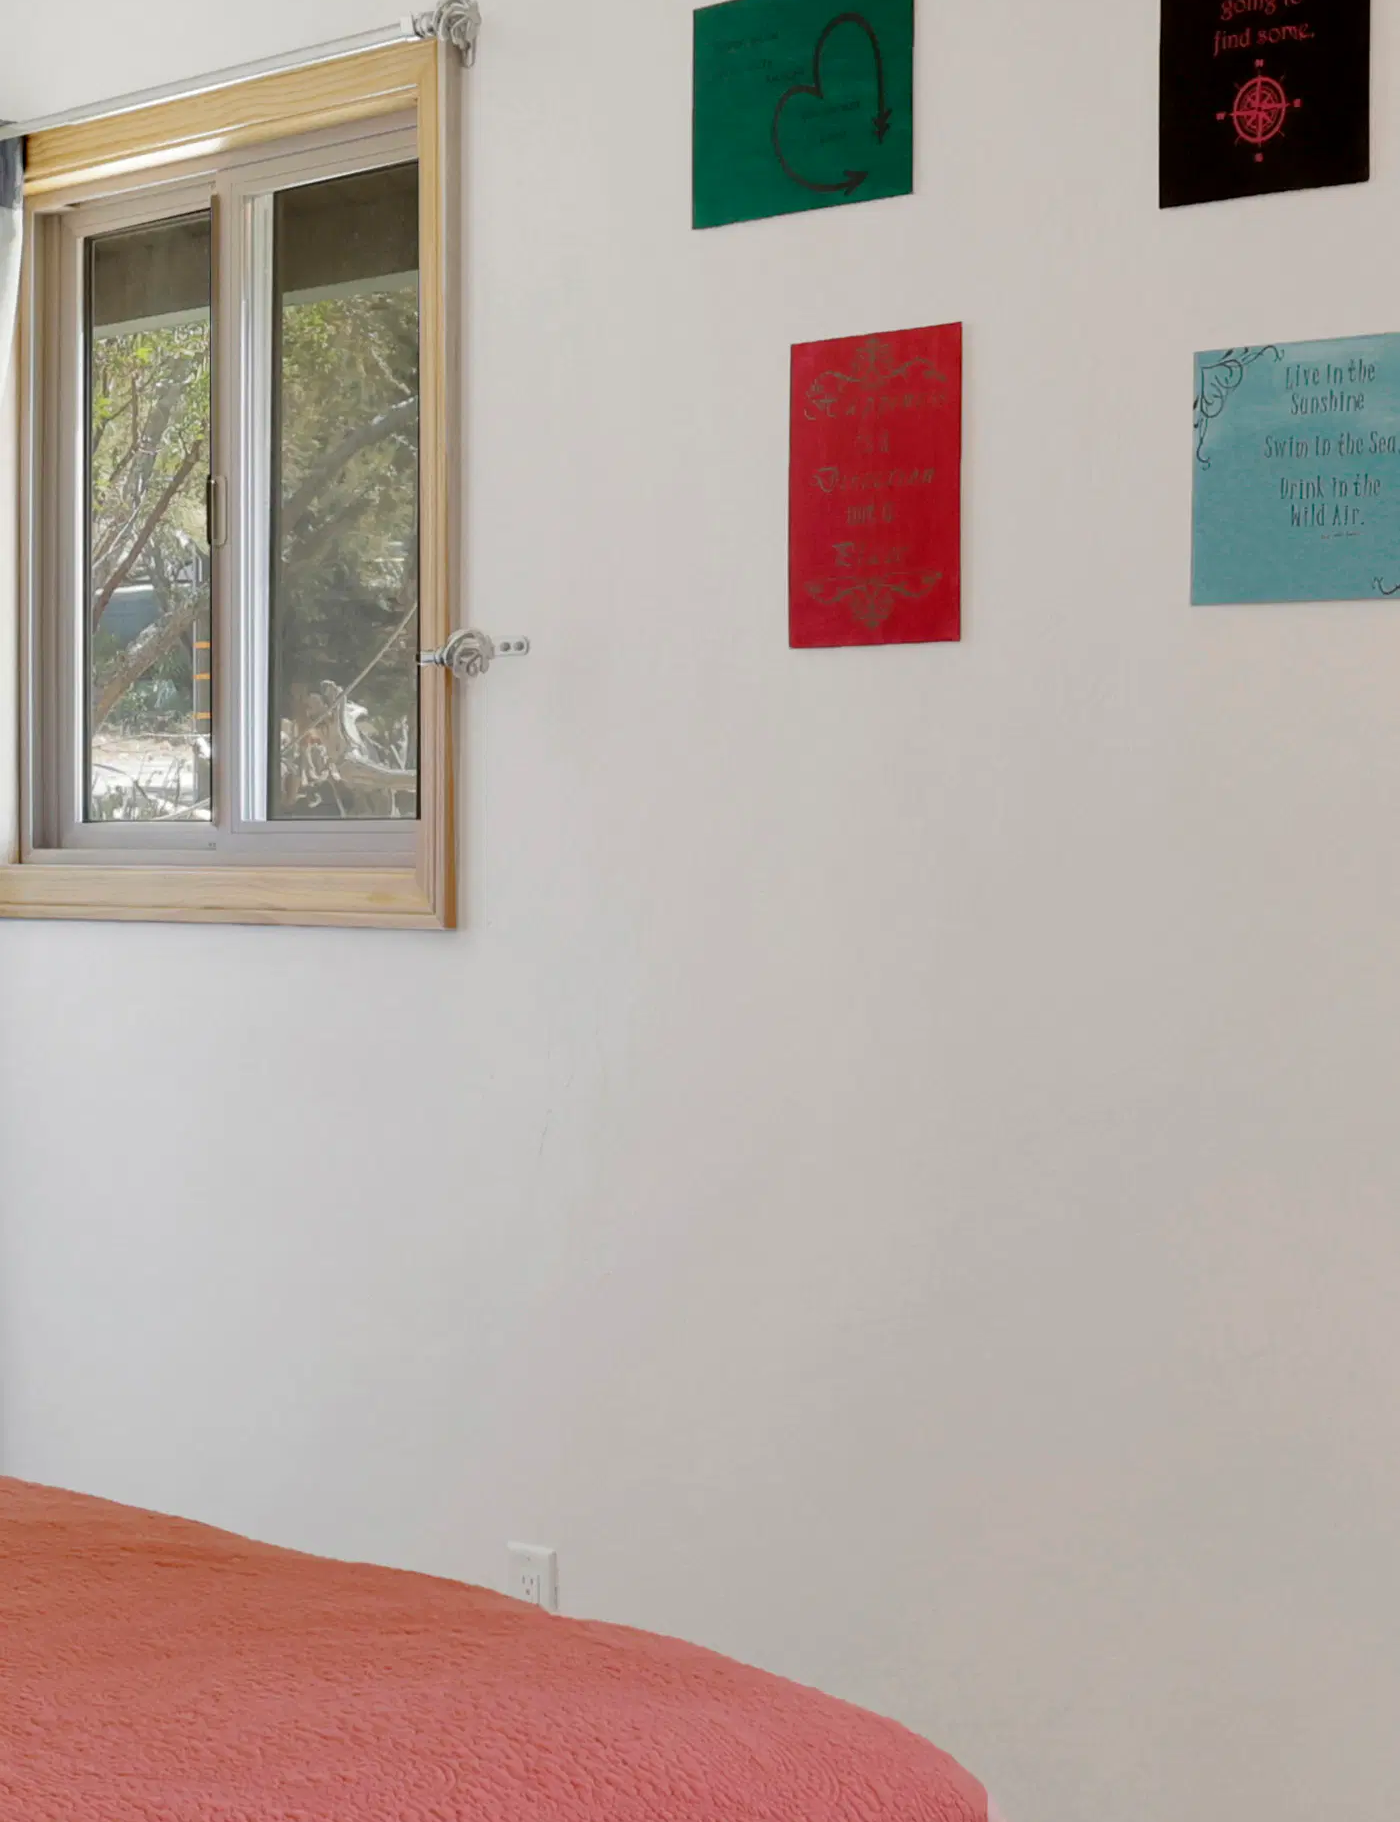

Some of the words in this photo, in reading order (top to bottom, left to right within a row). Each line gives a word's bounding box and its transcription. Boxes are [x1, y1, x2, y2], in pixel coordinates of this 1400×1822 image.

[1212, 26, 1251, 58] find
[1285, 363, 1320, 391] Live
[1347, 358, 1376, 384] the
[1290, 388, 1365, 416] Sunshine
[1264, 434, 1309, 459] Swim
[1338, 431, 1364, 457] the
[1280, 474, 1325, 500] Drink
[1354, 472, 1381, 498] the
[1290, 502, 1326, 528] Wild
[1332, 503, 1365, 527] Air.
